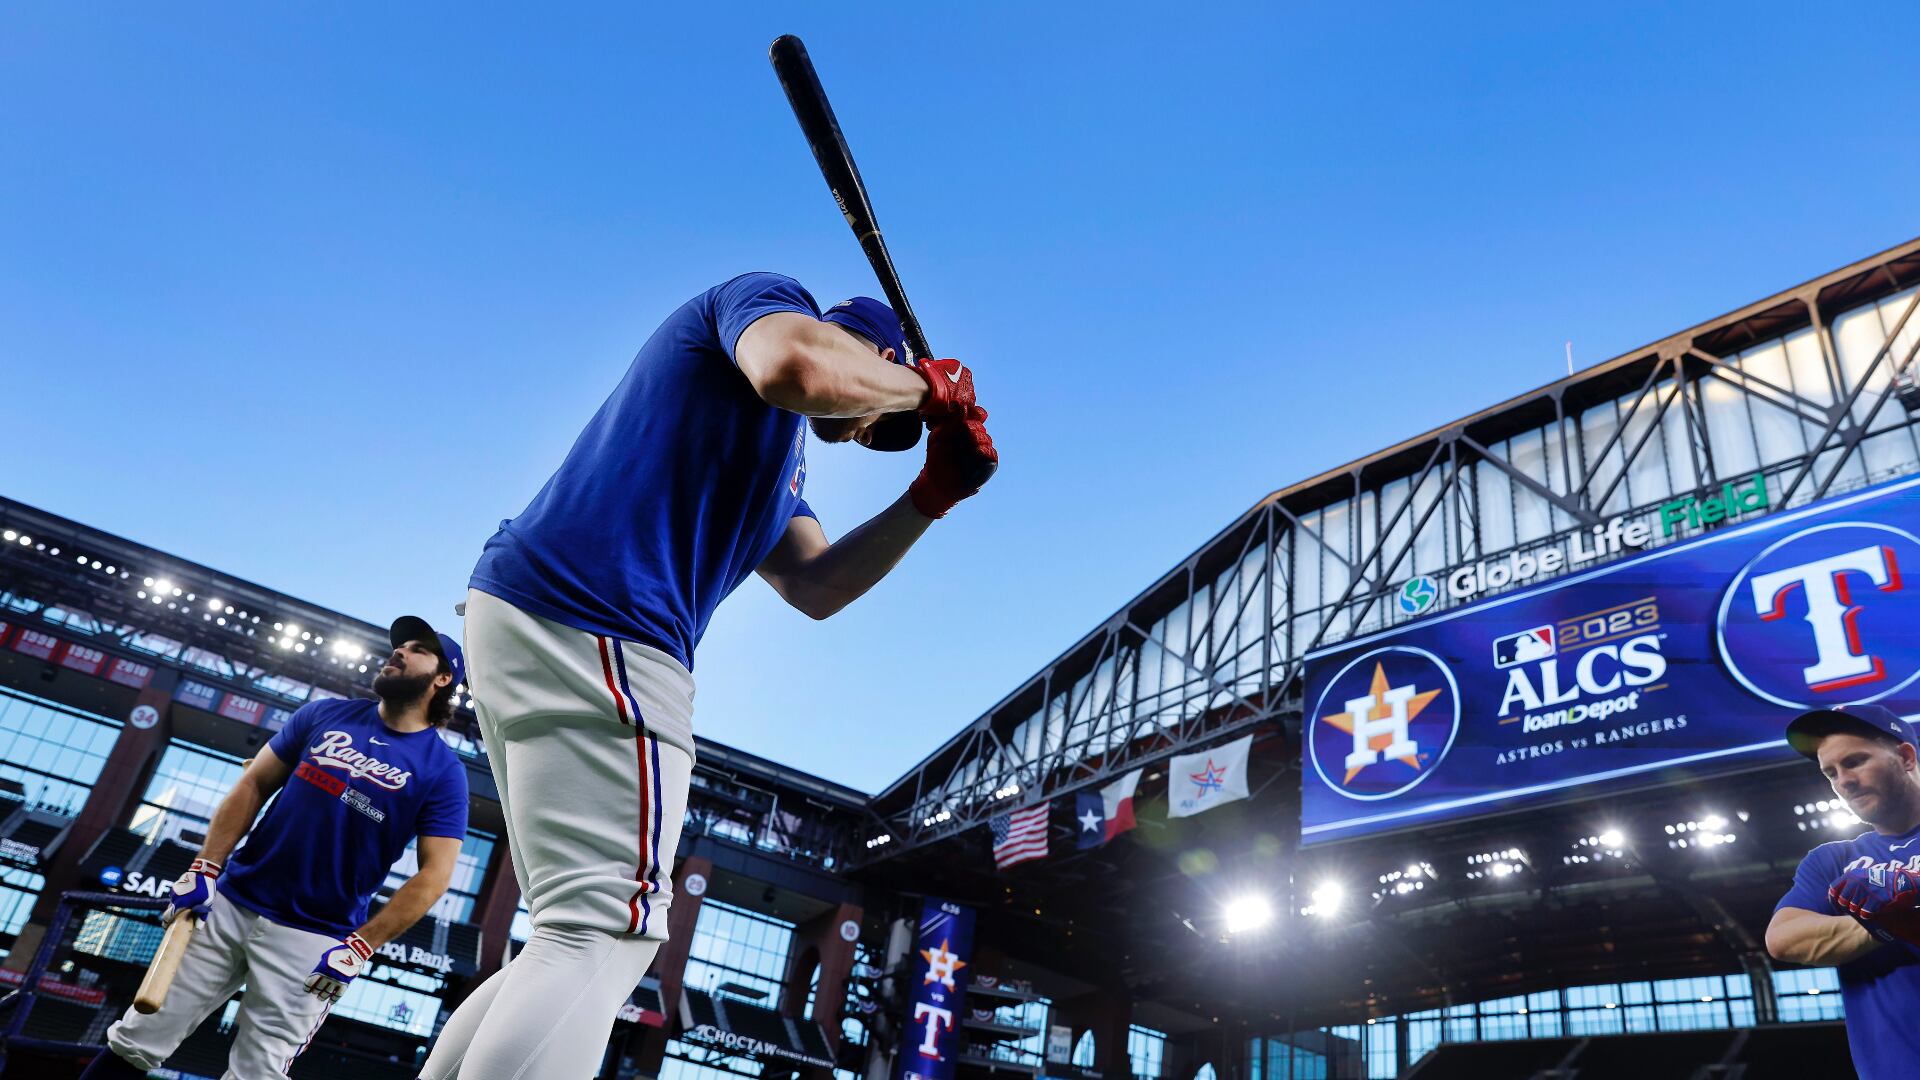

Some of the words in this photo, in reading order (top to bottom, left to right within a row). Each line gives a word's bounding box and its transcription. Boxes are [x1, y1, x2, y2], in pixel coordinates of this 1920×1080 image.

[1447, 546, 1563, 600] Globe
[1570, 517, 1650, 563] Life
[1659, 473, 1769, 538] Field
[1558, 604, 1660, 646] 2023
[1498, 635, 1667, 717] ALCS
[134, 710, 155, 726] 34
[229, 695, 260, 713] 2011
[1344, 684, 1418, 770] H
[1496, 740, 1565, 765] ASTROS
[1594, 715, 1689, 745] RANGERS
[310, 730, 413, 788] Rangers
[341, 792, 385, 822] POSTSEASON
[122, 871, 174, 899] SAF
[409, 946, 456, 973] Bank
[703, 1025, 778, 1056] CHOCTAW
